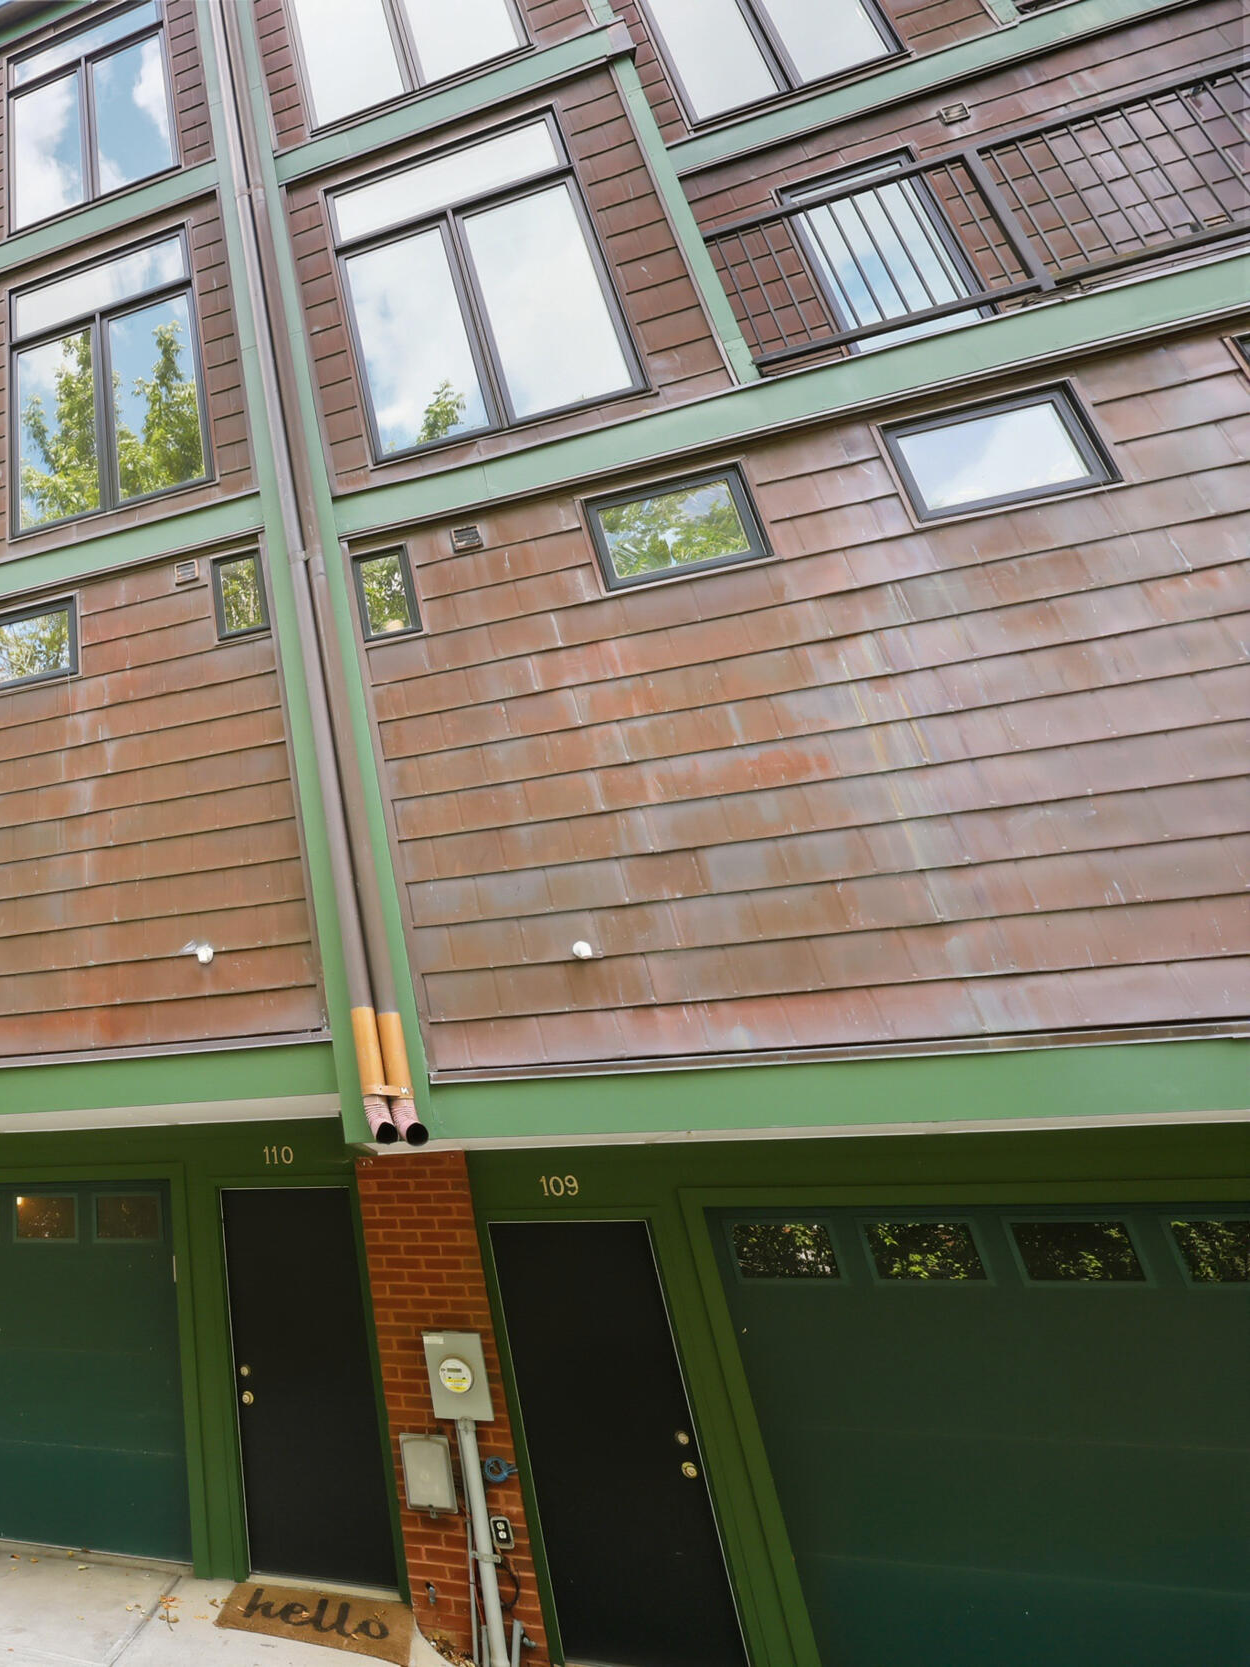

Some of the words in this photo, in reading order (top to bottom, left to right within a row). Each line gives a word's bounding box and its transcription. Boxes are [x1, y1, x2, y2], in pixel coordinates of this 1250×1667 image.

[263, 1146, 294, 1165] 110
[539, 1175, 579, 1197] 109
[243, 1588, 390, 1640] hello
